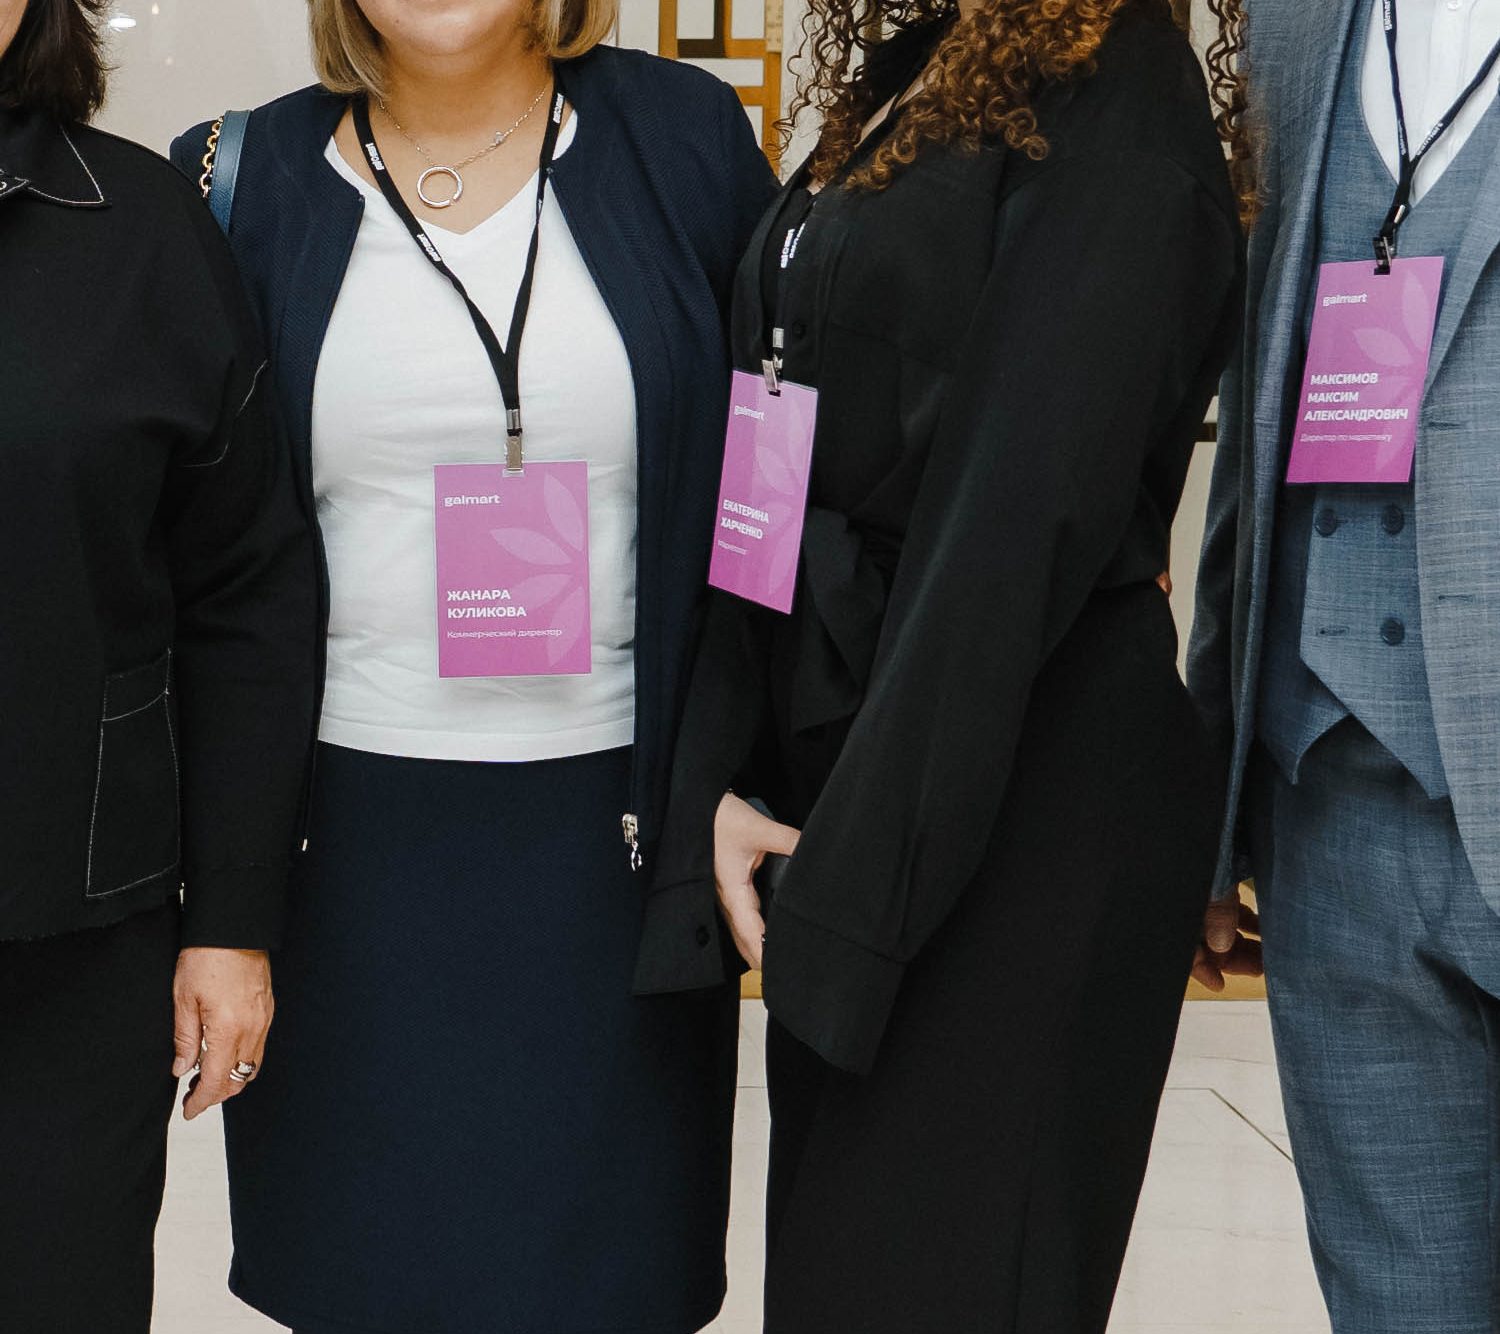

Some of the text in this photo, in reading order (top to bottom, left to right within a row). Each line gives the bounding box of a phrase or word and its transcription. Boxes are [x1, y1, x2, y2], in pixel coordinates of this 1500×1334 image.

[1310, 373, 1378, 385] МАКСИМОВ
[1307, 391, 1359, 403] МАКСИМ
[1303, 408, 1408, 422] АЛЕКСАНДРОВИЧ
[444, 493, 501, 507] galmart
[447, 589, 511, 601] ЖАНАРА
[447, 606, 527, 619] КУЛИКОВА
